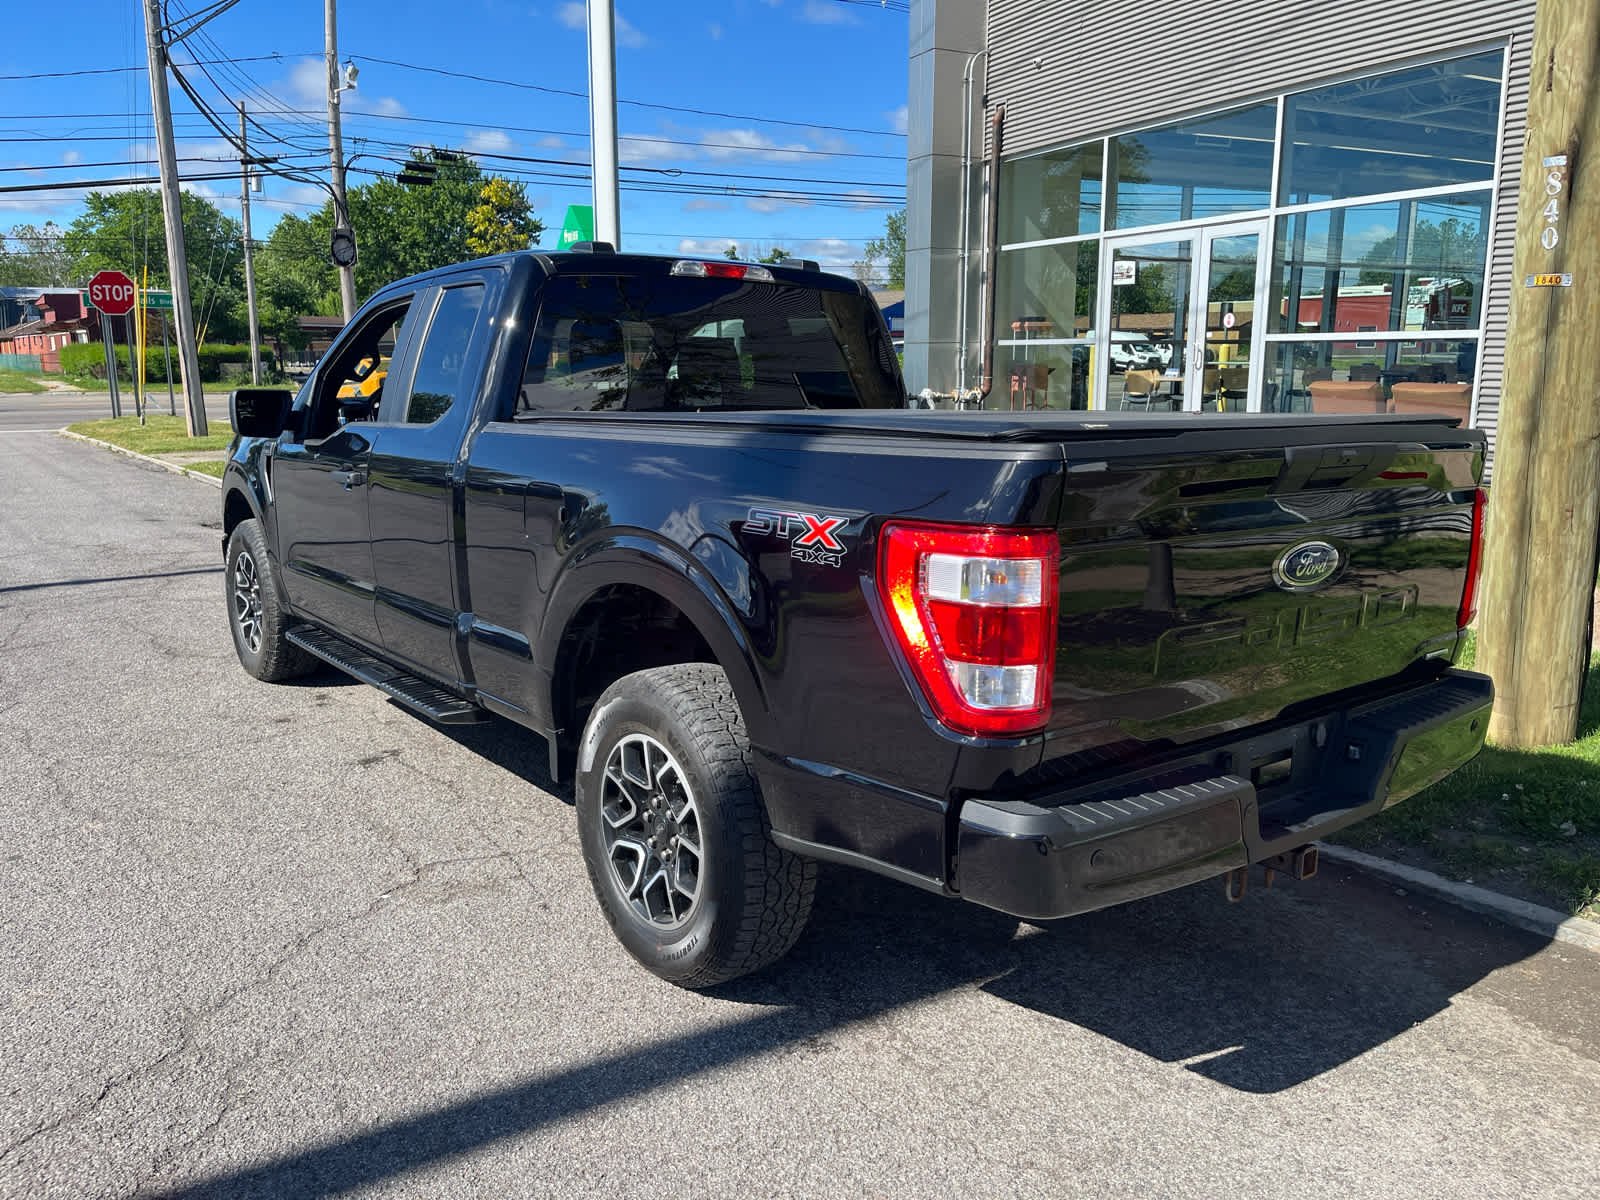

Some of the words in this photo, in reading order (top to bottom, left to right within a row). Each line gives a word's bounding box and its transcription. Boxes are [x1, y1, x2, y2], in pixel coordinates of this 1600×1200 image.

[92, 284, 133, 302] STOP
[1451, 303, 1467, 313] KFC
[741, 505, 850, 555] STX
[1295, 551, 1329, 577] Ford
